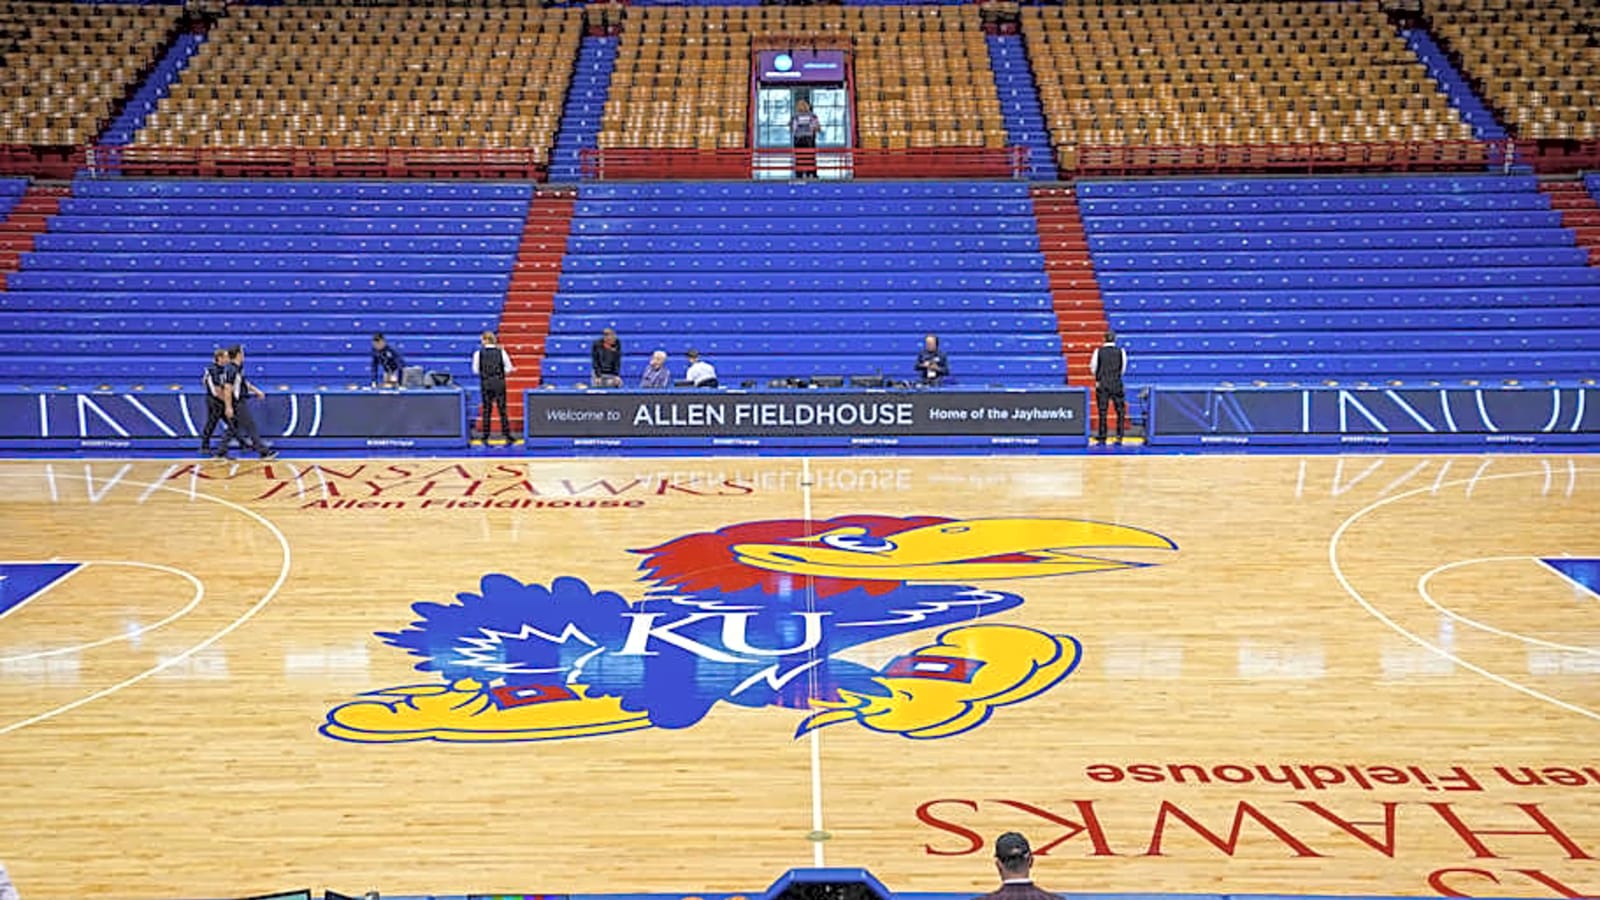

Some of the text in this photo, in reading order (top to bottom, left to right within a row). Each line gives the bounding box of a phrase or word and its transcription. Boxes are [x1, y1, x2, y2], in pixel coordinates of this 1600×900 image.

[546, 403, 1074, 426] Welcome to ALLEN FIELDHOUSE Home of the Jayhawks
[253, 479, 754, 500] JAYHAWKS
[302, 499, 646, 509] Allen Fieldhouse
[608, 612, 833, 663] KU
[1086, 763, 1484, 791] Fieldhouse
